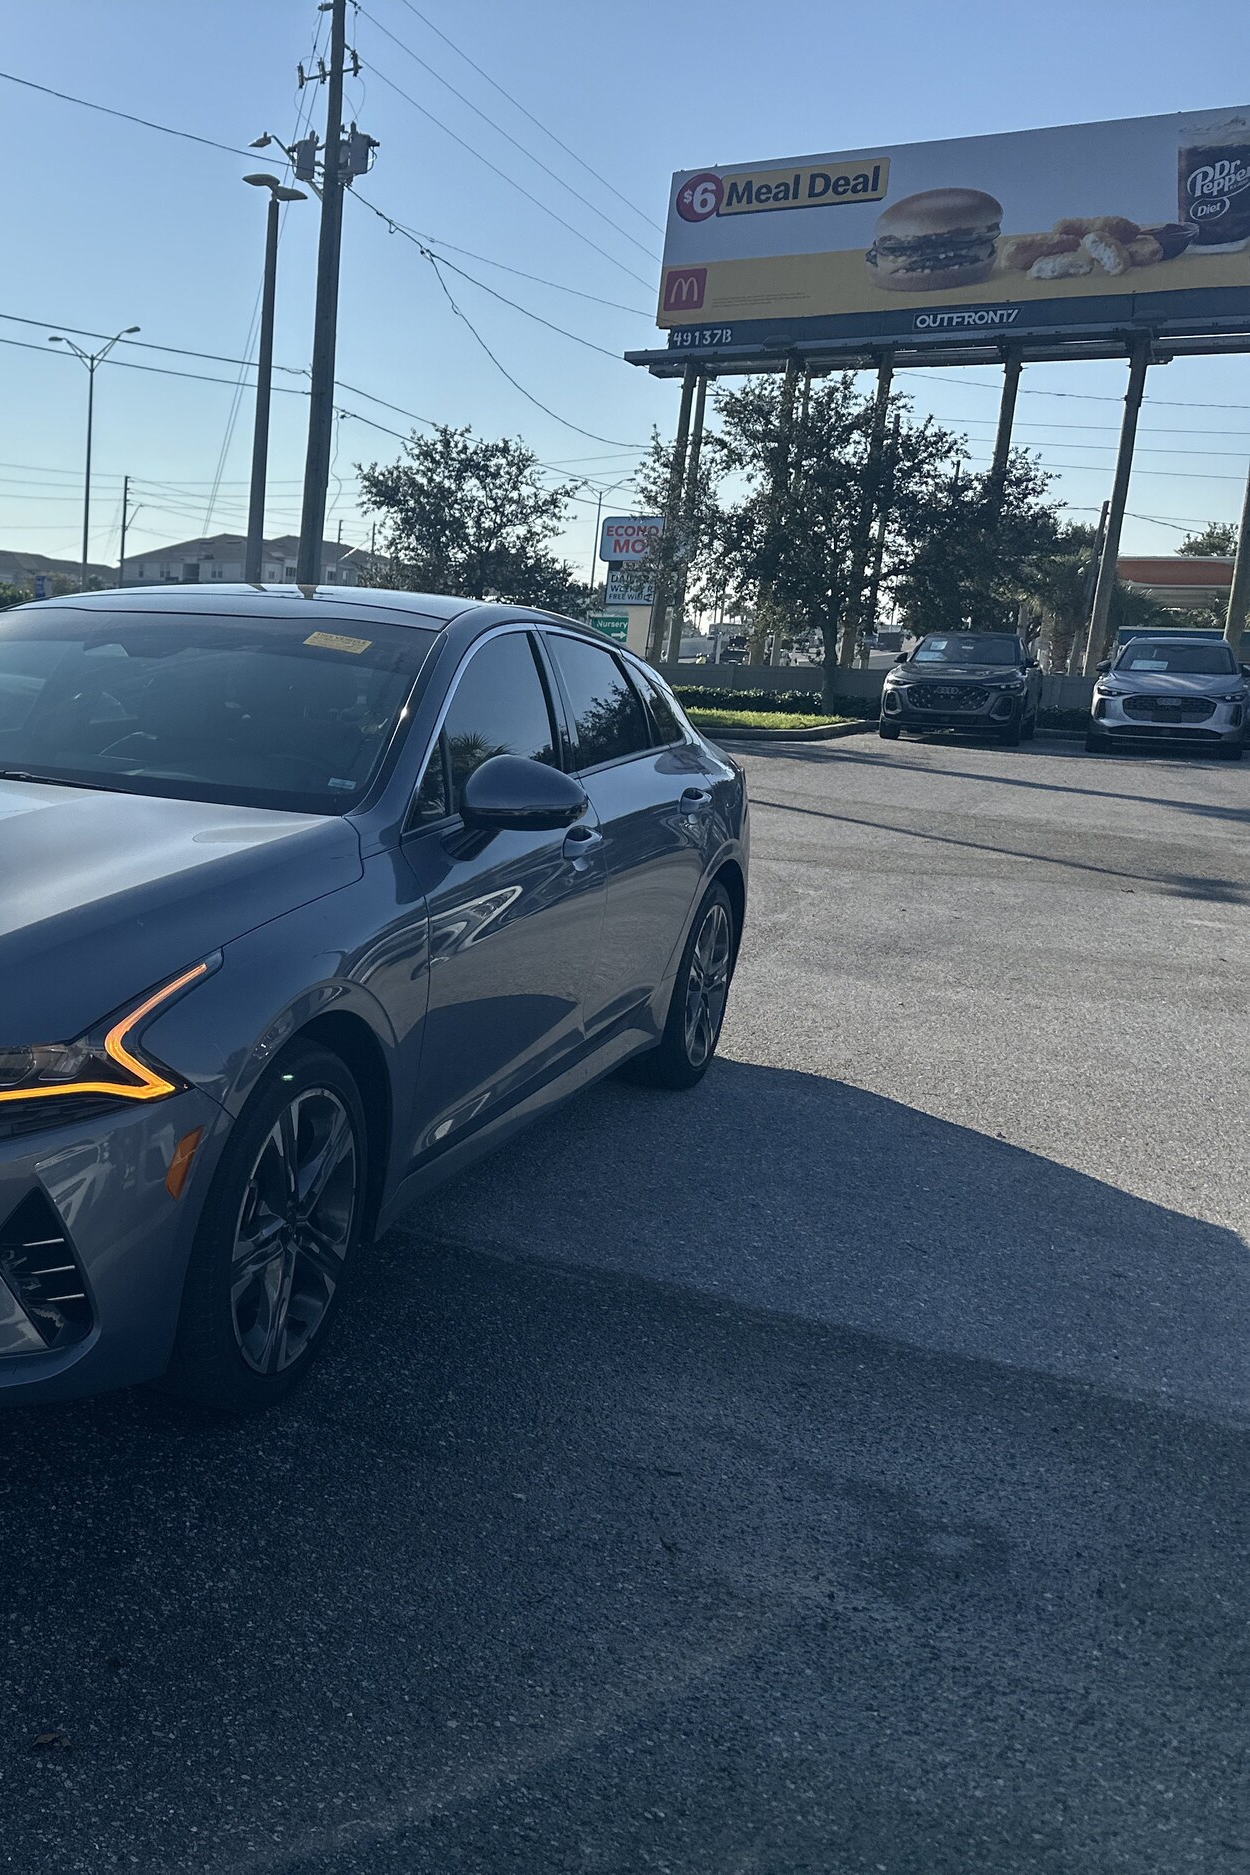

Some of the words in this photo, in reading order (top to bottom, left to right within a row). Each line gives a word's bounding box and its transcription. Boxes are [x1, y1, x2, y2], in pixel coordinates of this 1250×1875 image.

[1214, 159, 1241, 180] Dr
[683, 181, 717, 214] $6
[725, 174, 801, 207] Meal
[807, 165, 881, 198] Deal
[1197, 203, 1221, 217] Diet
[673, 329, 732, 346] 49137B
[613, 539, 653, 553] MO
[597, 619, 628, 630] Nursery
